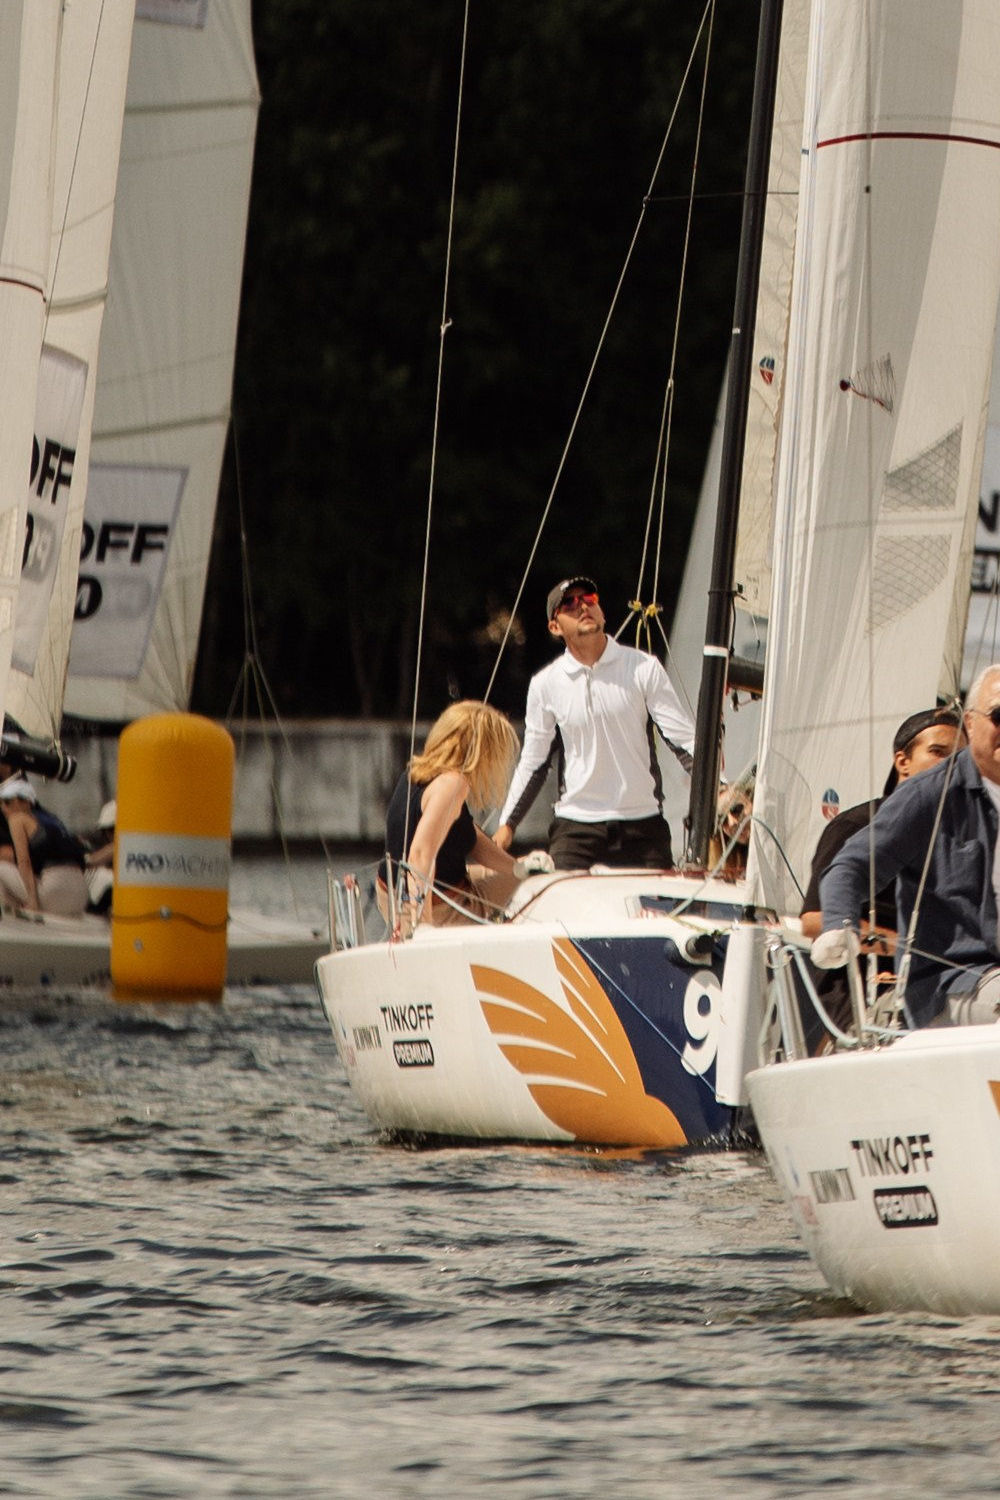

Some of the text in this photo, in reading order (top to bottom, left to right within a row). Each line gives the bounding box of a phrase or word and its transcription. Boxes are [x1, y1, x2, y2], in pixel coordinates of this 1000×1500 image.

[379, 1004, 435, 1033] TINKOFF
[681, 969, 723, 1077] 9
[850, 1133, 934, 1178] TINKOFF
